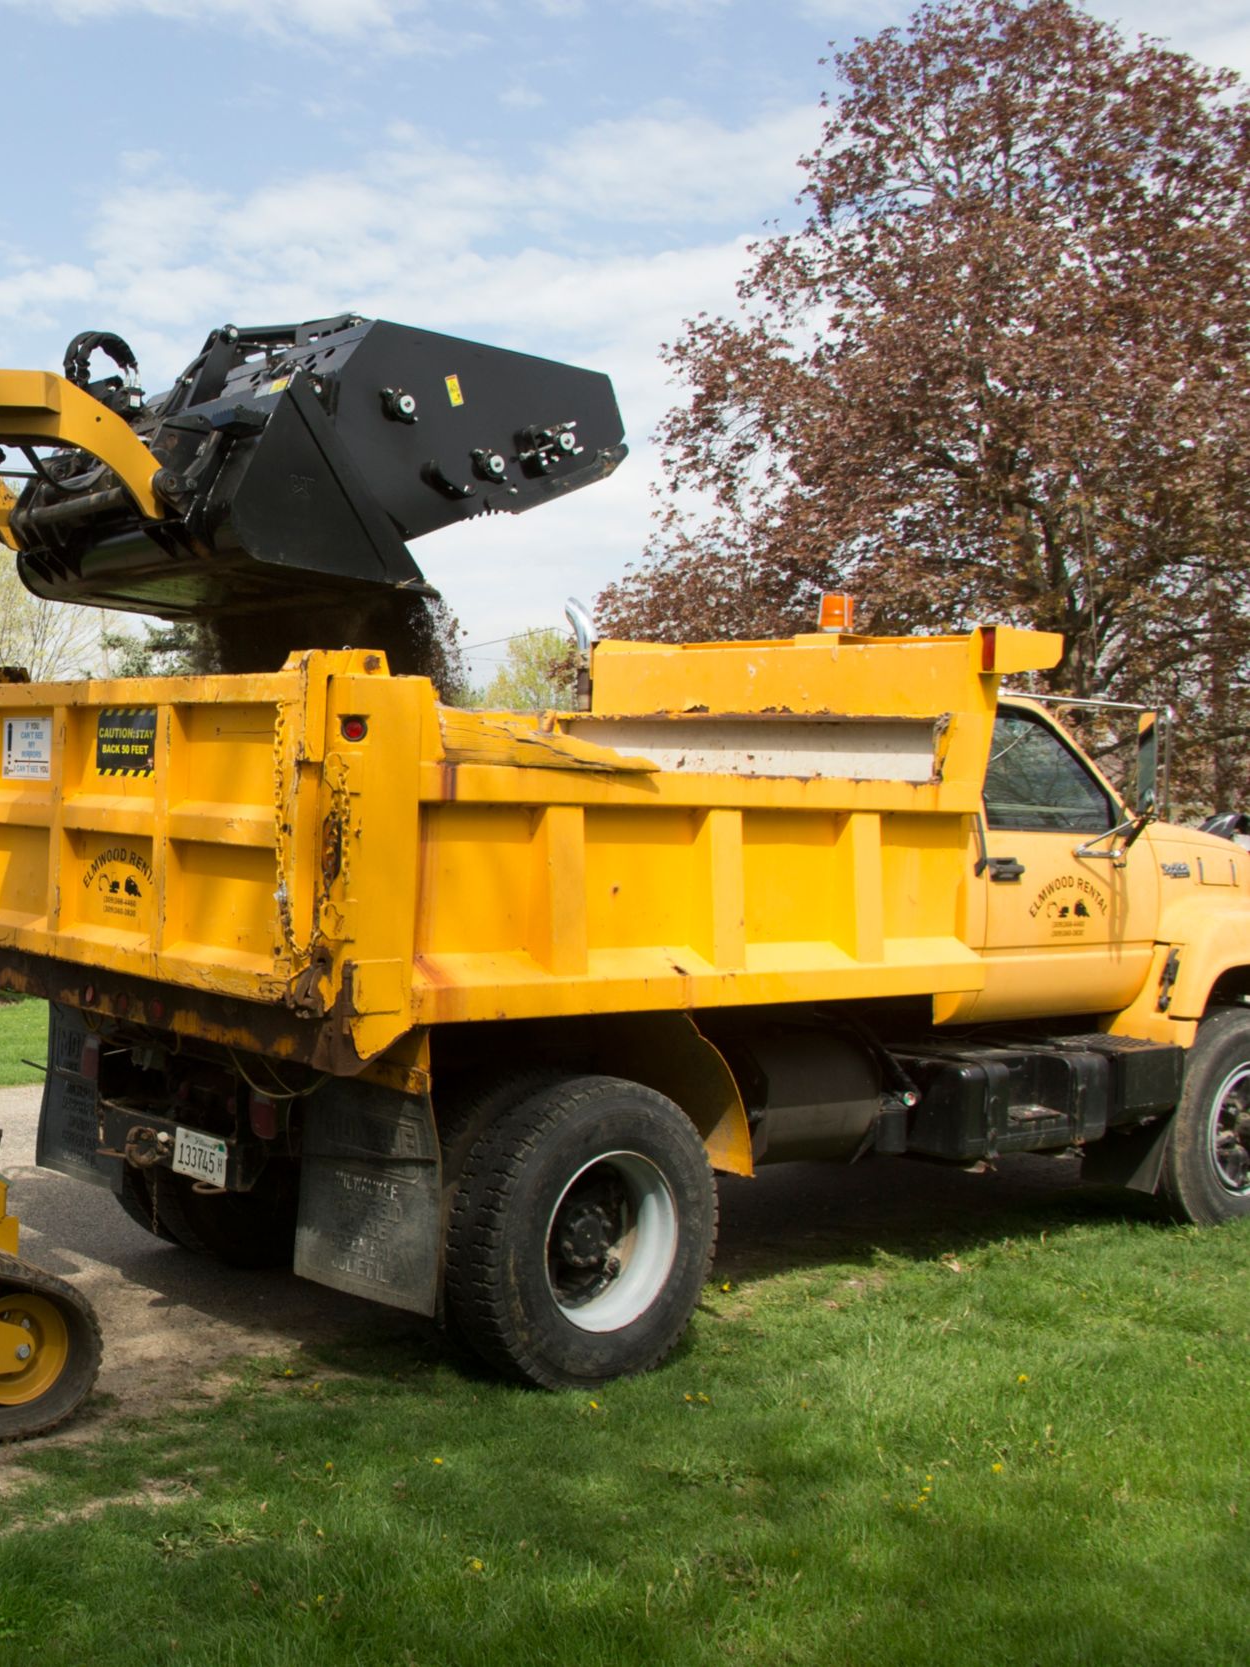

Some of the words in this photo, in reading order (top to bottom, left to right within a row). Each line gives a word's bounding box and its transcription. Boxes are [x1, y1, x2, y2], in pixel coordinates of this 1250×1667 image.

[102, 744, 120, 753] BACK
[121, 745, 130, 754] 50
[131, 745, 149, 755] FEET
[82, 848, 127, 889] ELMWOOD
[129, 851, 154, 885] RENT
[1029, 876, 1075, 918] ELMWOOD
[1077, 877, 1108, 916] RENTAL
[177, 1142, 216, 1174] 133745
